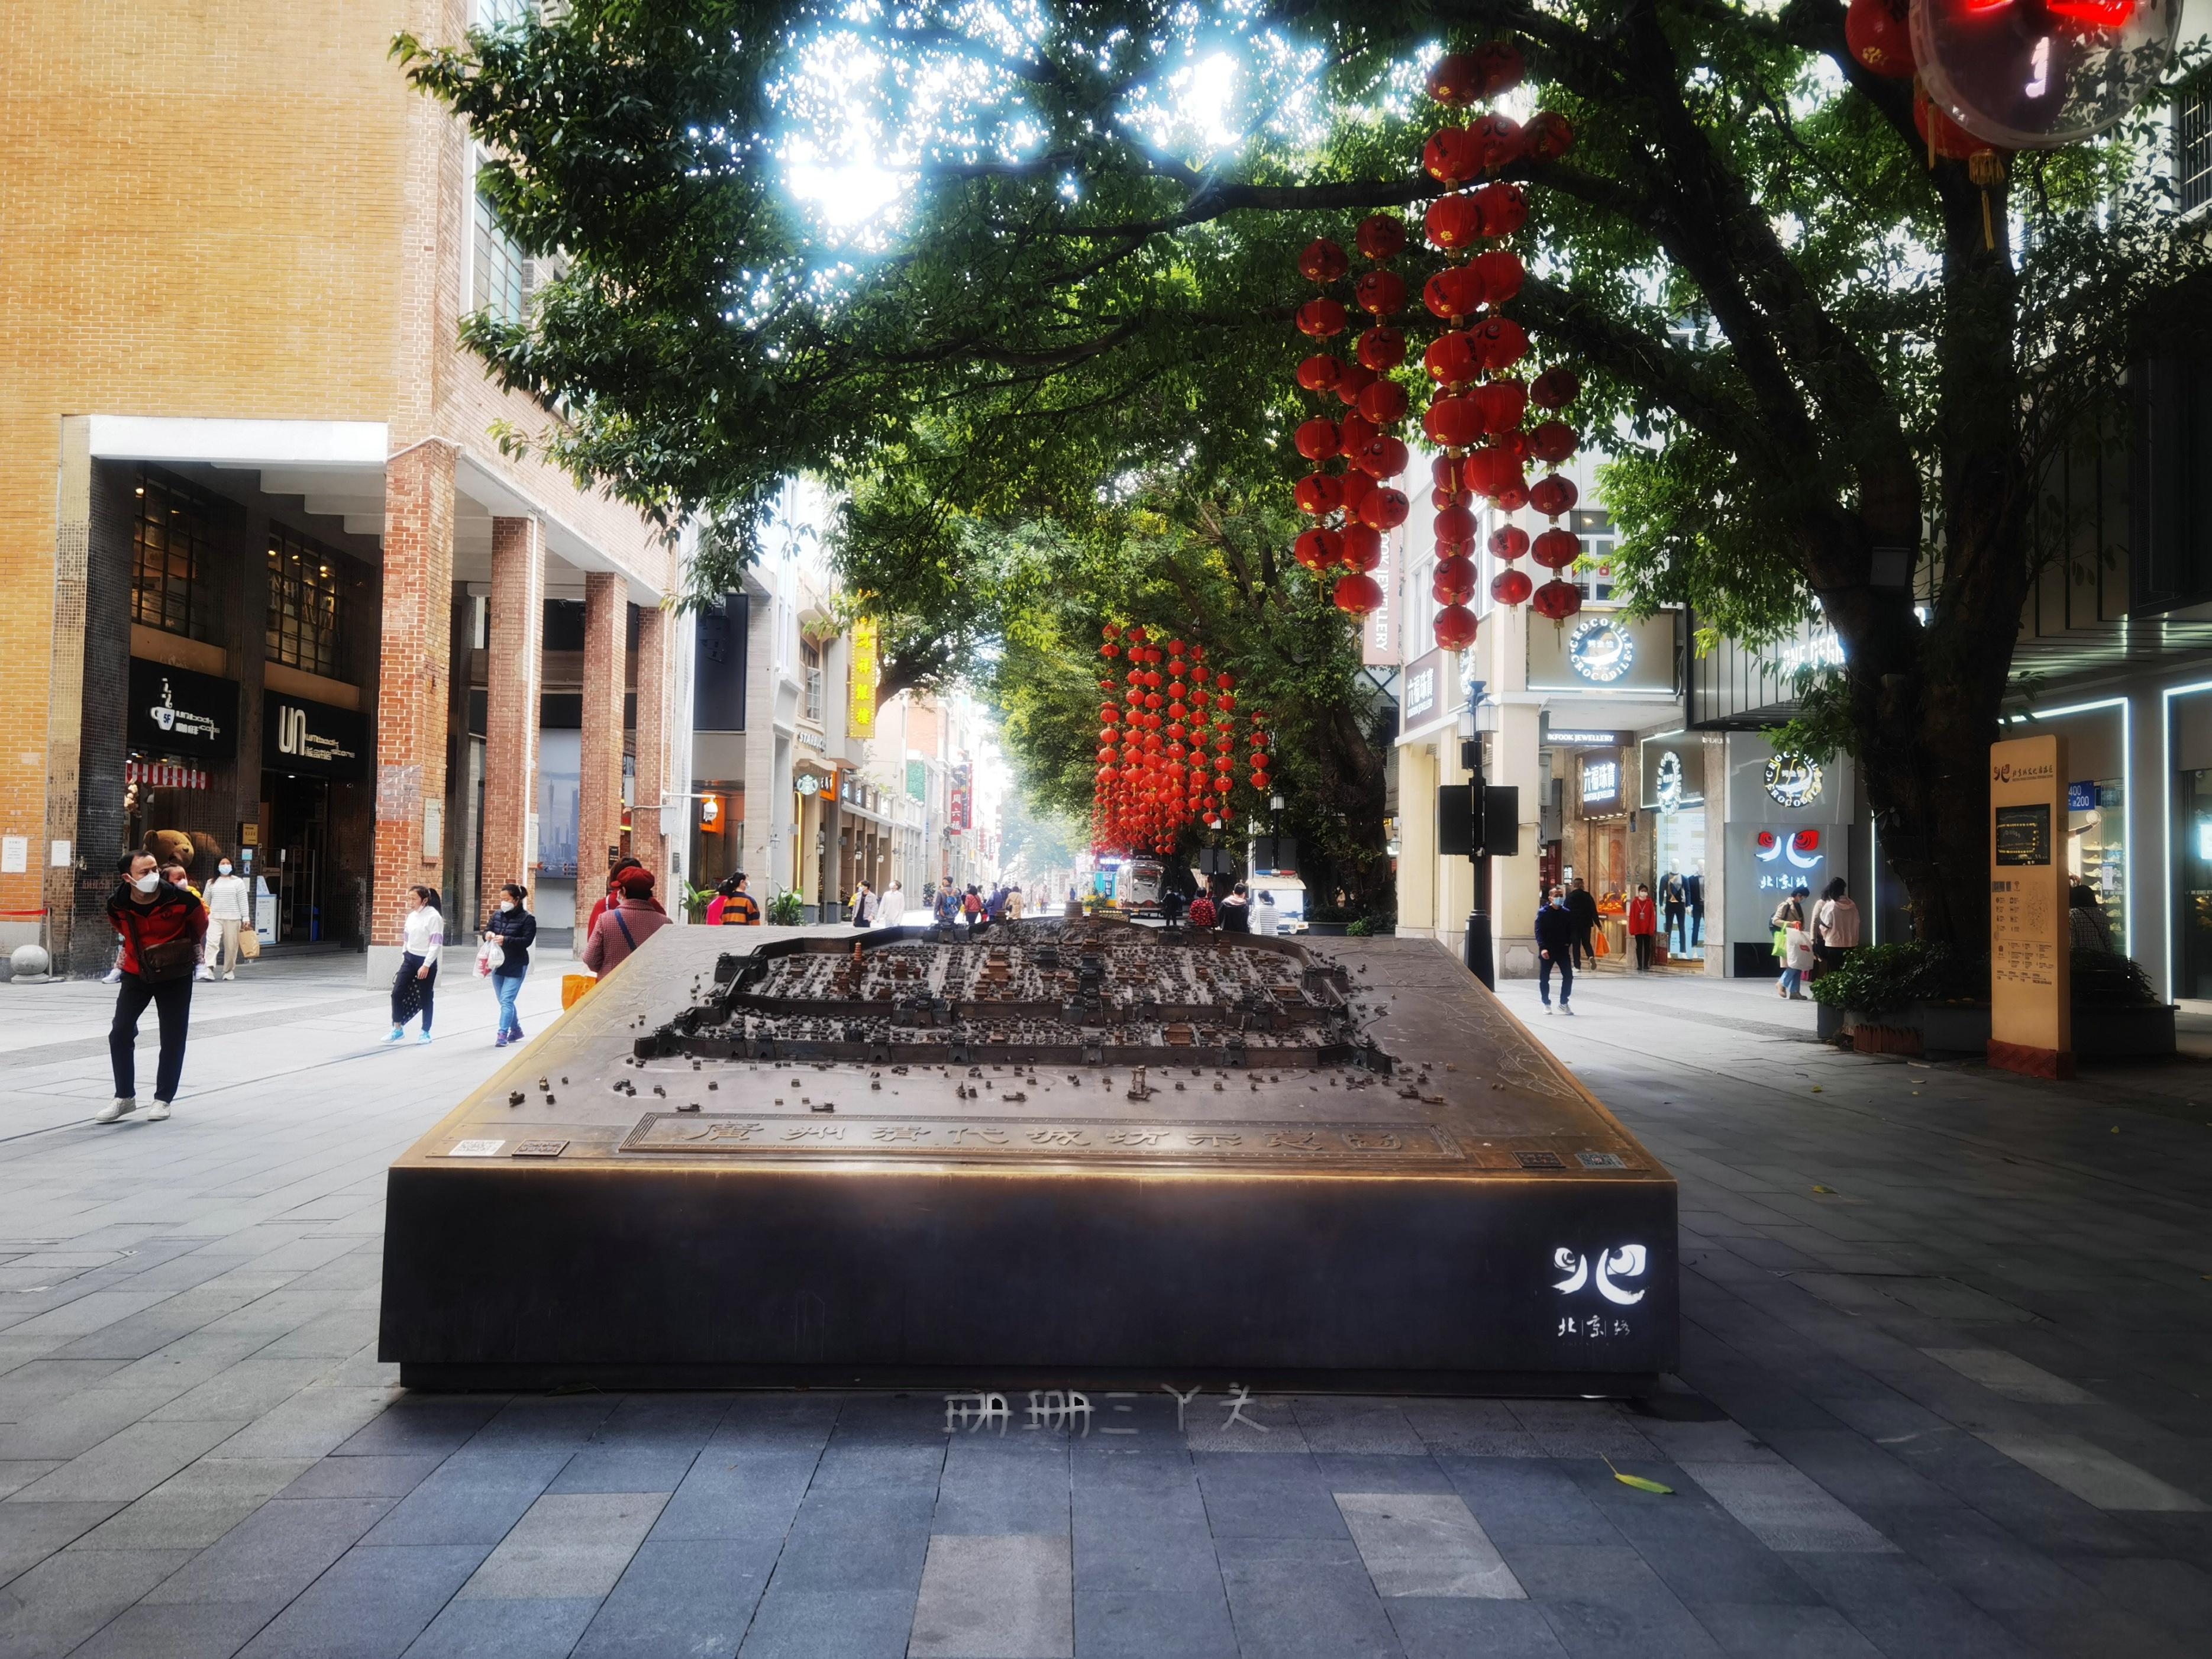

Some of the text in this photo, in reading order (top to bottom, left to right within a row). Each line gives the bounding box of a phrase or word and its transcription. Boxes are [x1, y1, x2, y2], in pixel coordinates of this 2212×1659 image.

[163, 713, 171, 724] 5F
[1584, 762, 1616, 792] 六福珠寶
[951, 794, 962, 831] 周六福
[1557, 1314, 1630, 1338] 北京路
